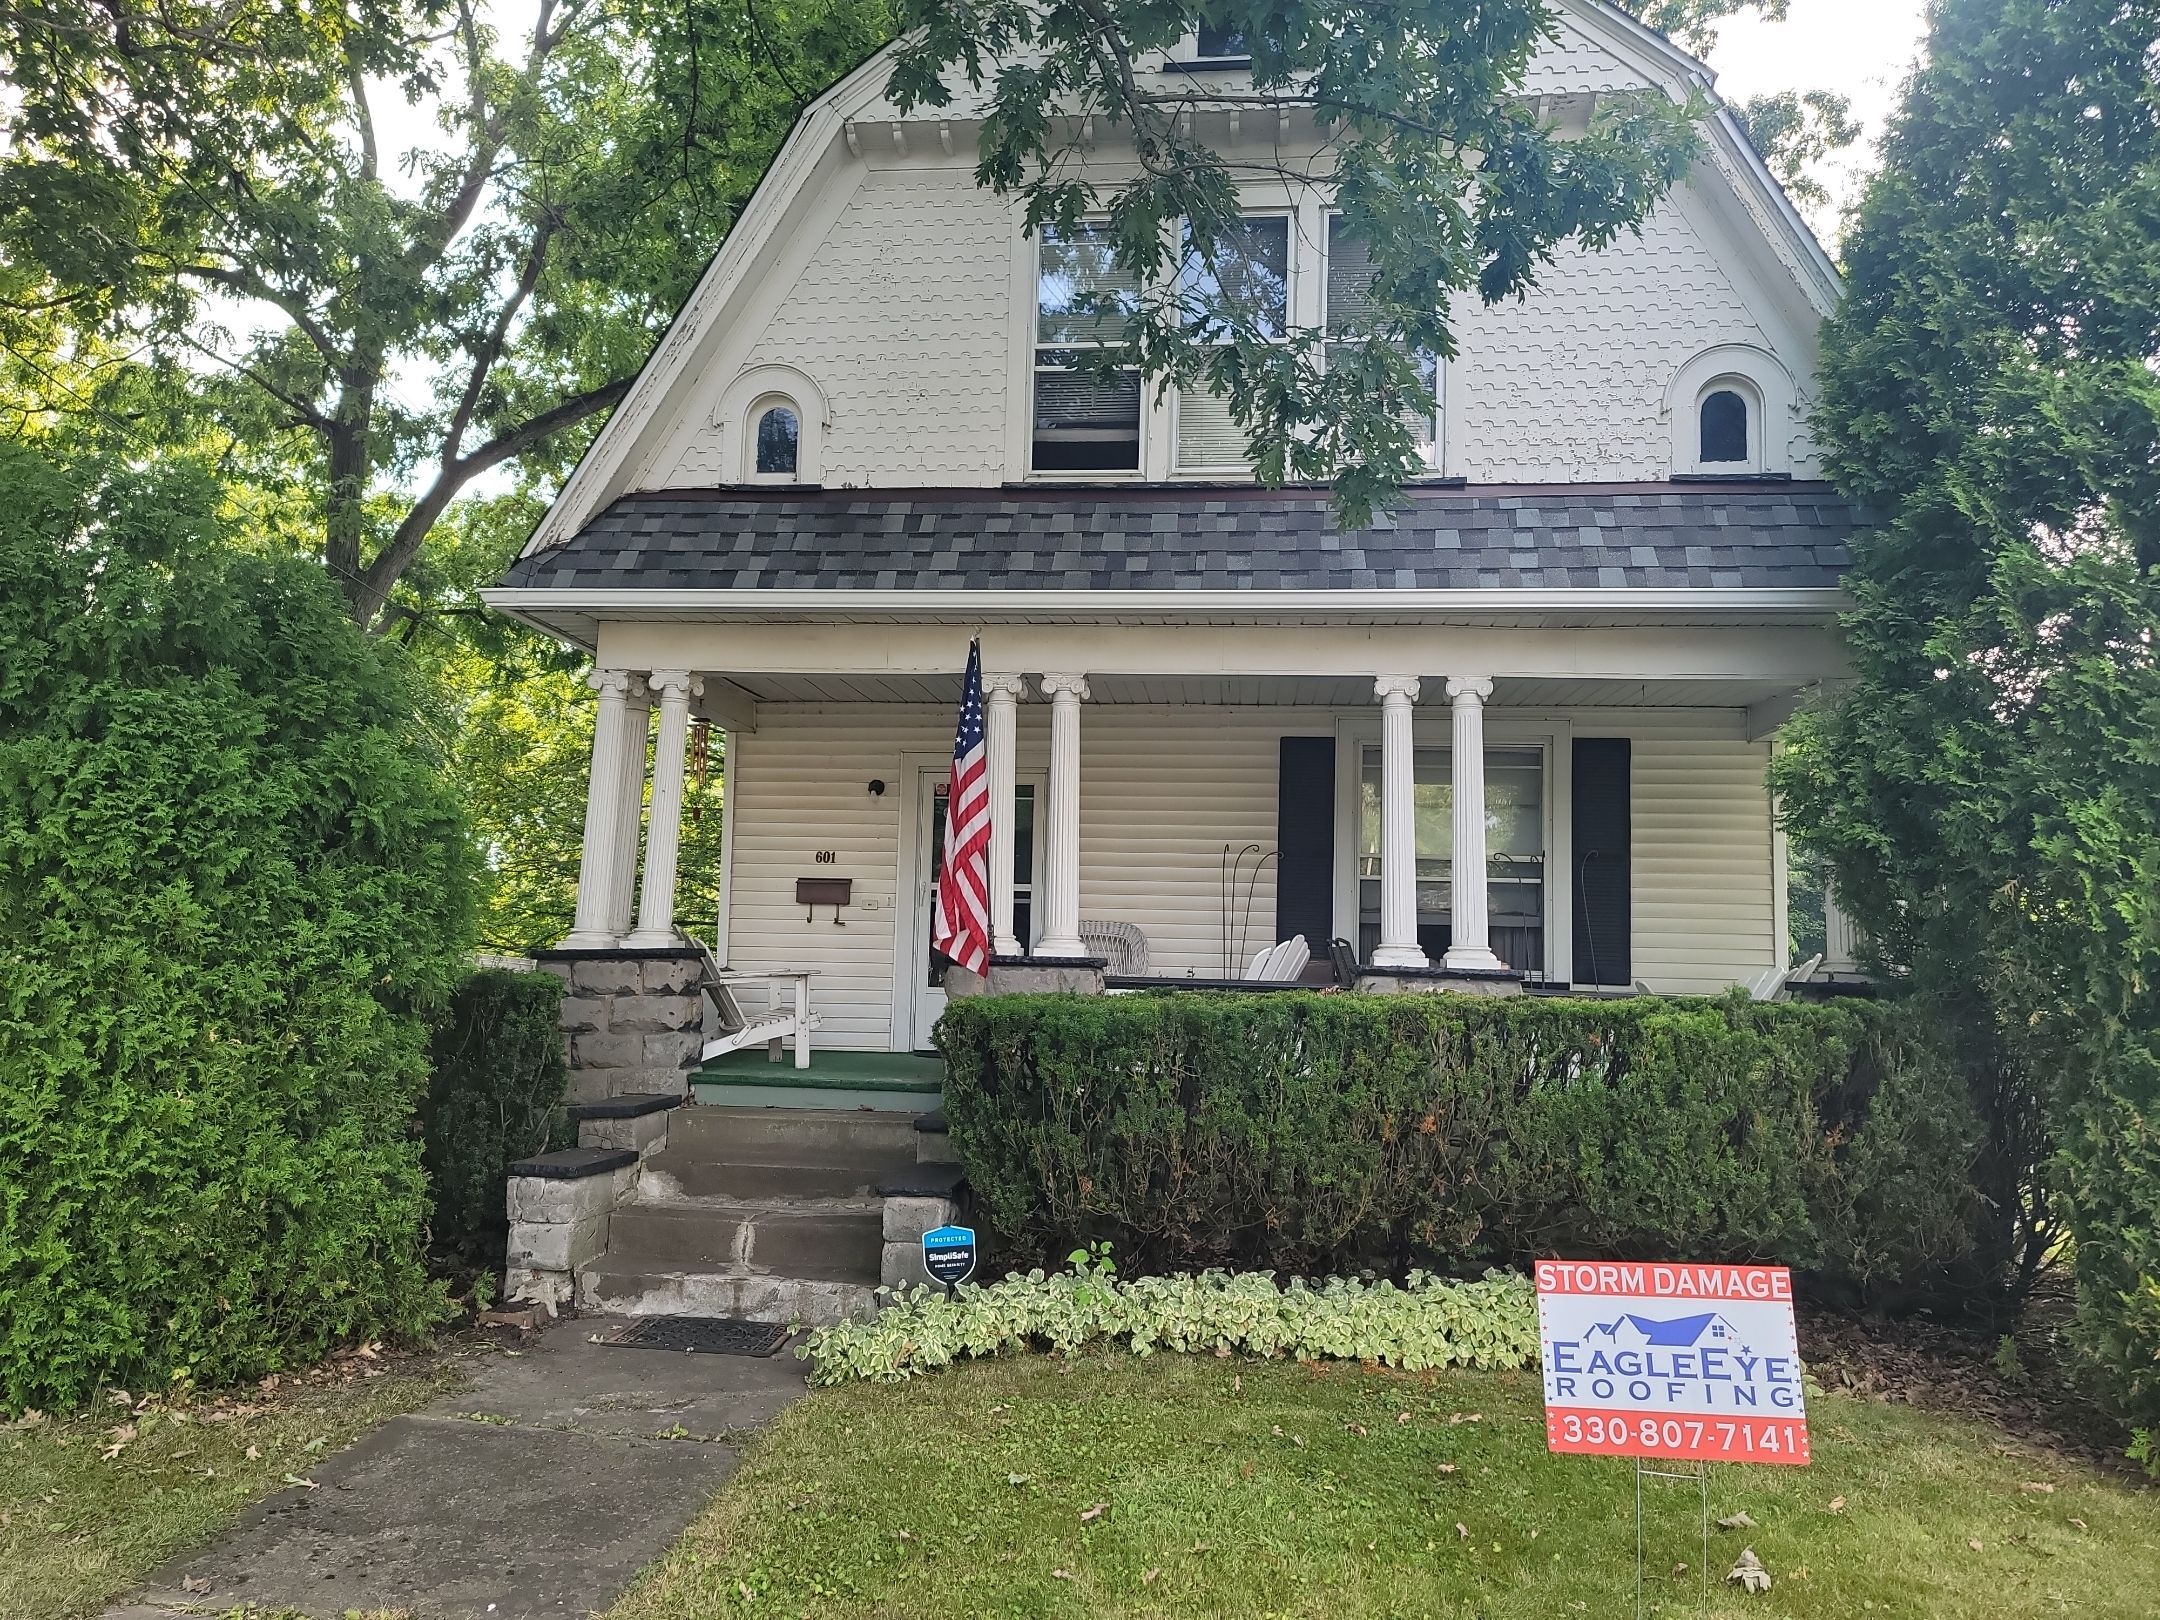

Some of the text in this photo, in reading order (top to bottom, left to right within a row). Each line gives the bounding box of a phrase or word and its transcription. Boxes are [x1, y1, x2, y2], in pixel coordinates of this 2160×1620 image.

[815, 851, 836, 863] 601
[929, 1251, 969, 1262] SimpliSafe
[1538, 1264, 1791, 1298] STORM DAMAGE
[1556, 1377, 1794, 1407] ROOFING
[1562, 1415, 1796, 1453] 330-807-7141
